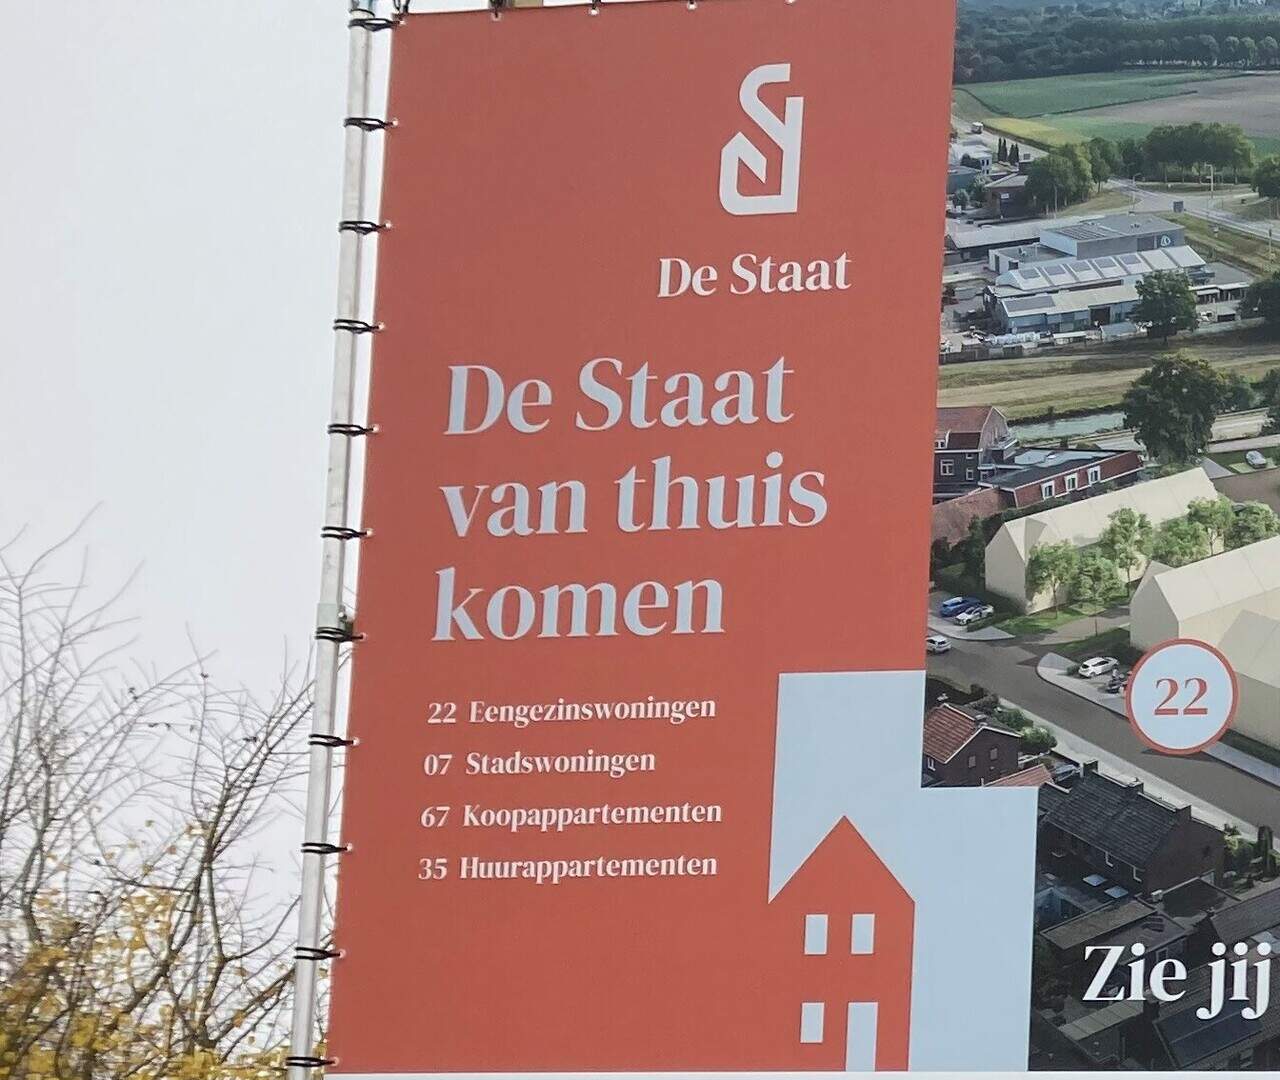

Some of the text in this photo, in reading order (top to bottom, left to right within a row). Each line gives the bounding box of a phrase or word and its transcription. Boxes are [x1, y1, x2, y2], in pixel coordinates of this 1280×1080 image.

[658, 253, 851, 297] De Staat
[444, 357, 794, 434] De Staat
[439, 452, 827, 537] van thuis
[432, 567, 724, 640] komen
[428, 696, 715, 728] 22 Eengezinswoningen
[1154, 678, 1208, 715] 22
[424, 749, 655, 778] 07 Stadswoningen
[421, 803, 721, 832] 67 Koopappartementen
[419, 856, 716, 885] 35 Huurappartementen
[1083, 943, 1186, 1001] Zie
[1197, 942, 1271, 1019] jij
